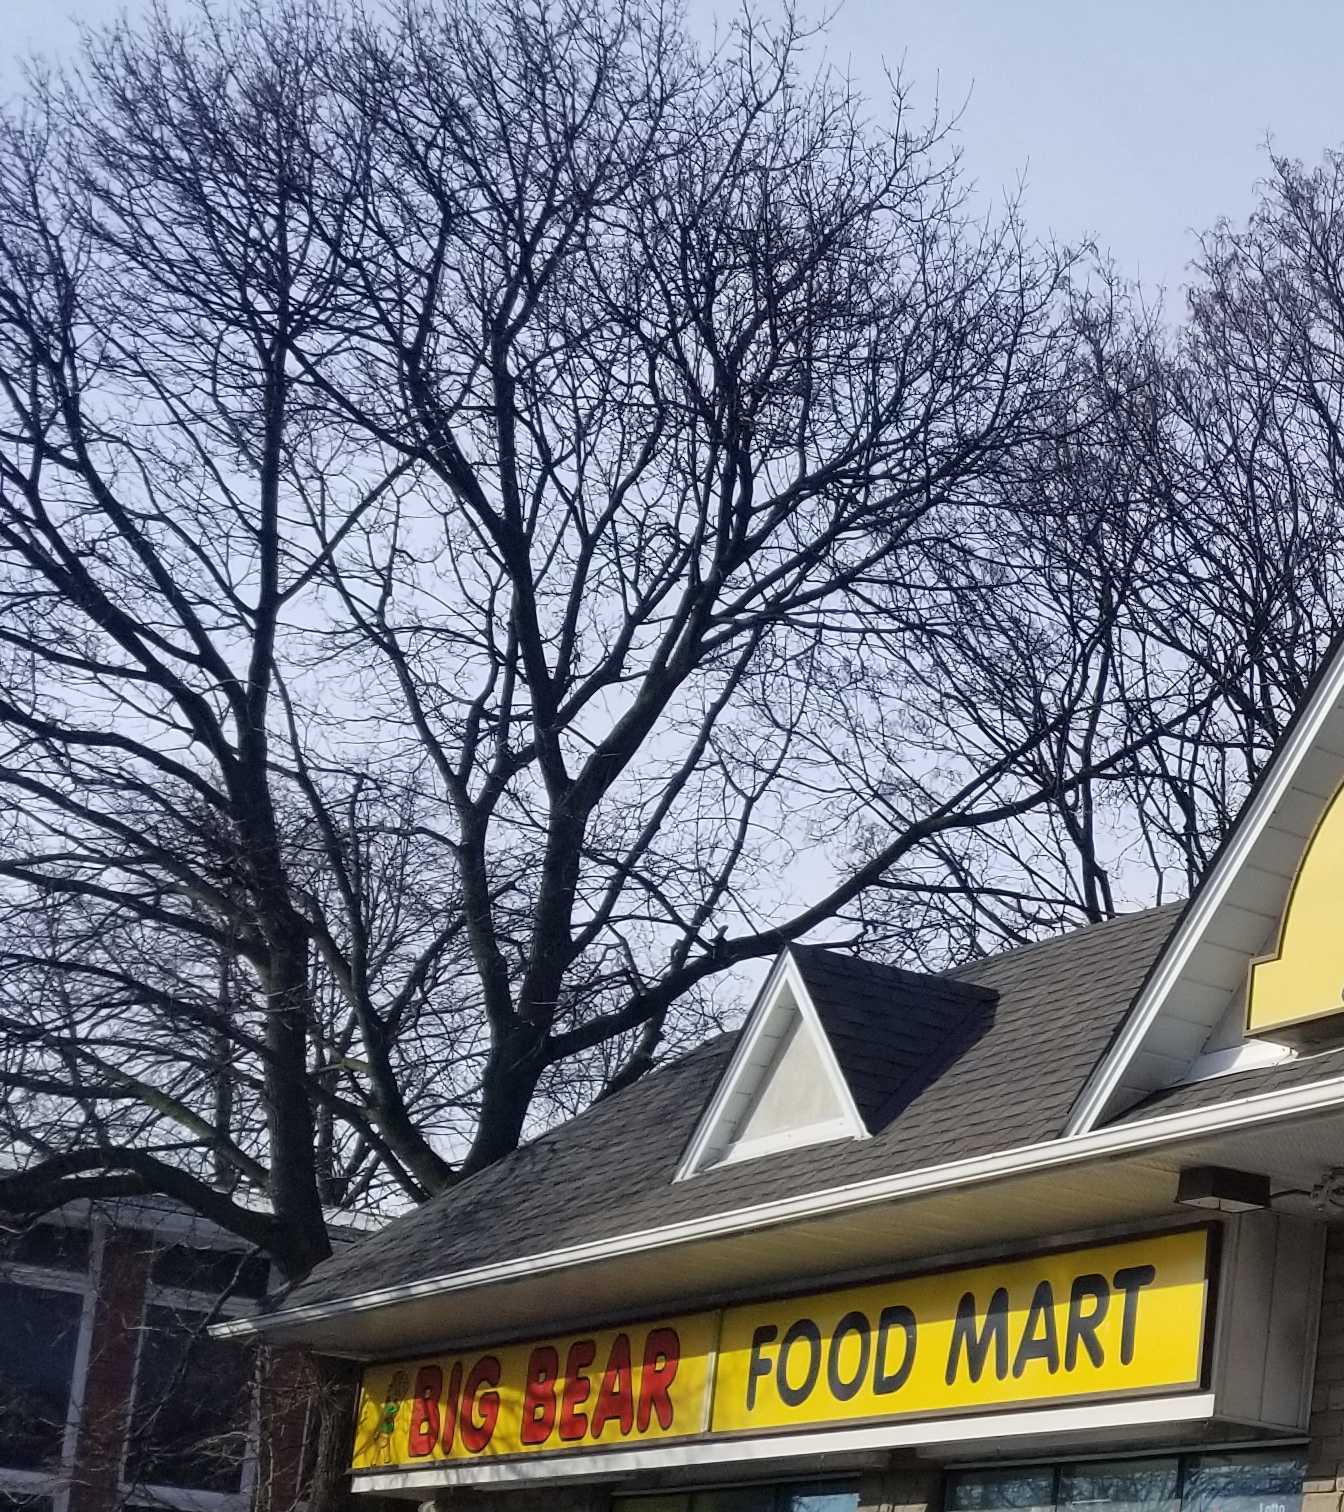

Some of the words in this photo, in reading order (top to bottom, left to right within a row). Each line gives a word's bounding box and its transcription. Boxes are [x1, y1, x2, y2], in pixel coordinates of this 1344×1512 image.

[408, 1354, 501, 1458] BIG
[520, 1327, 681, 1446] BEAR
[745, 1305, 917, 1412] FOOD
[944, 1264, 1156, 1387] MART
